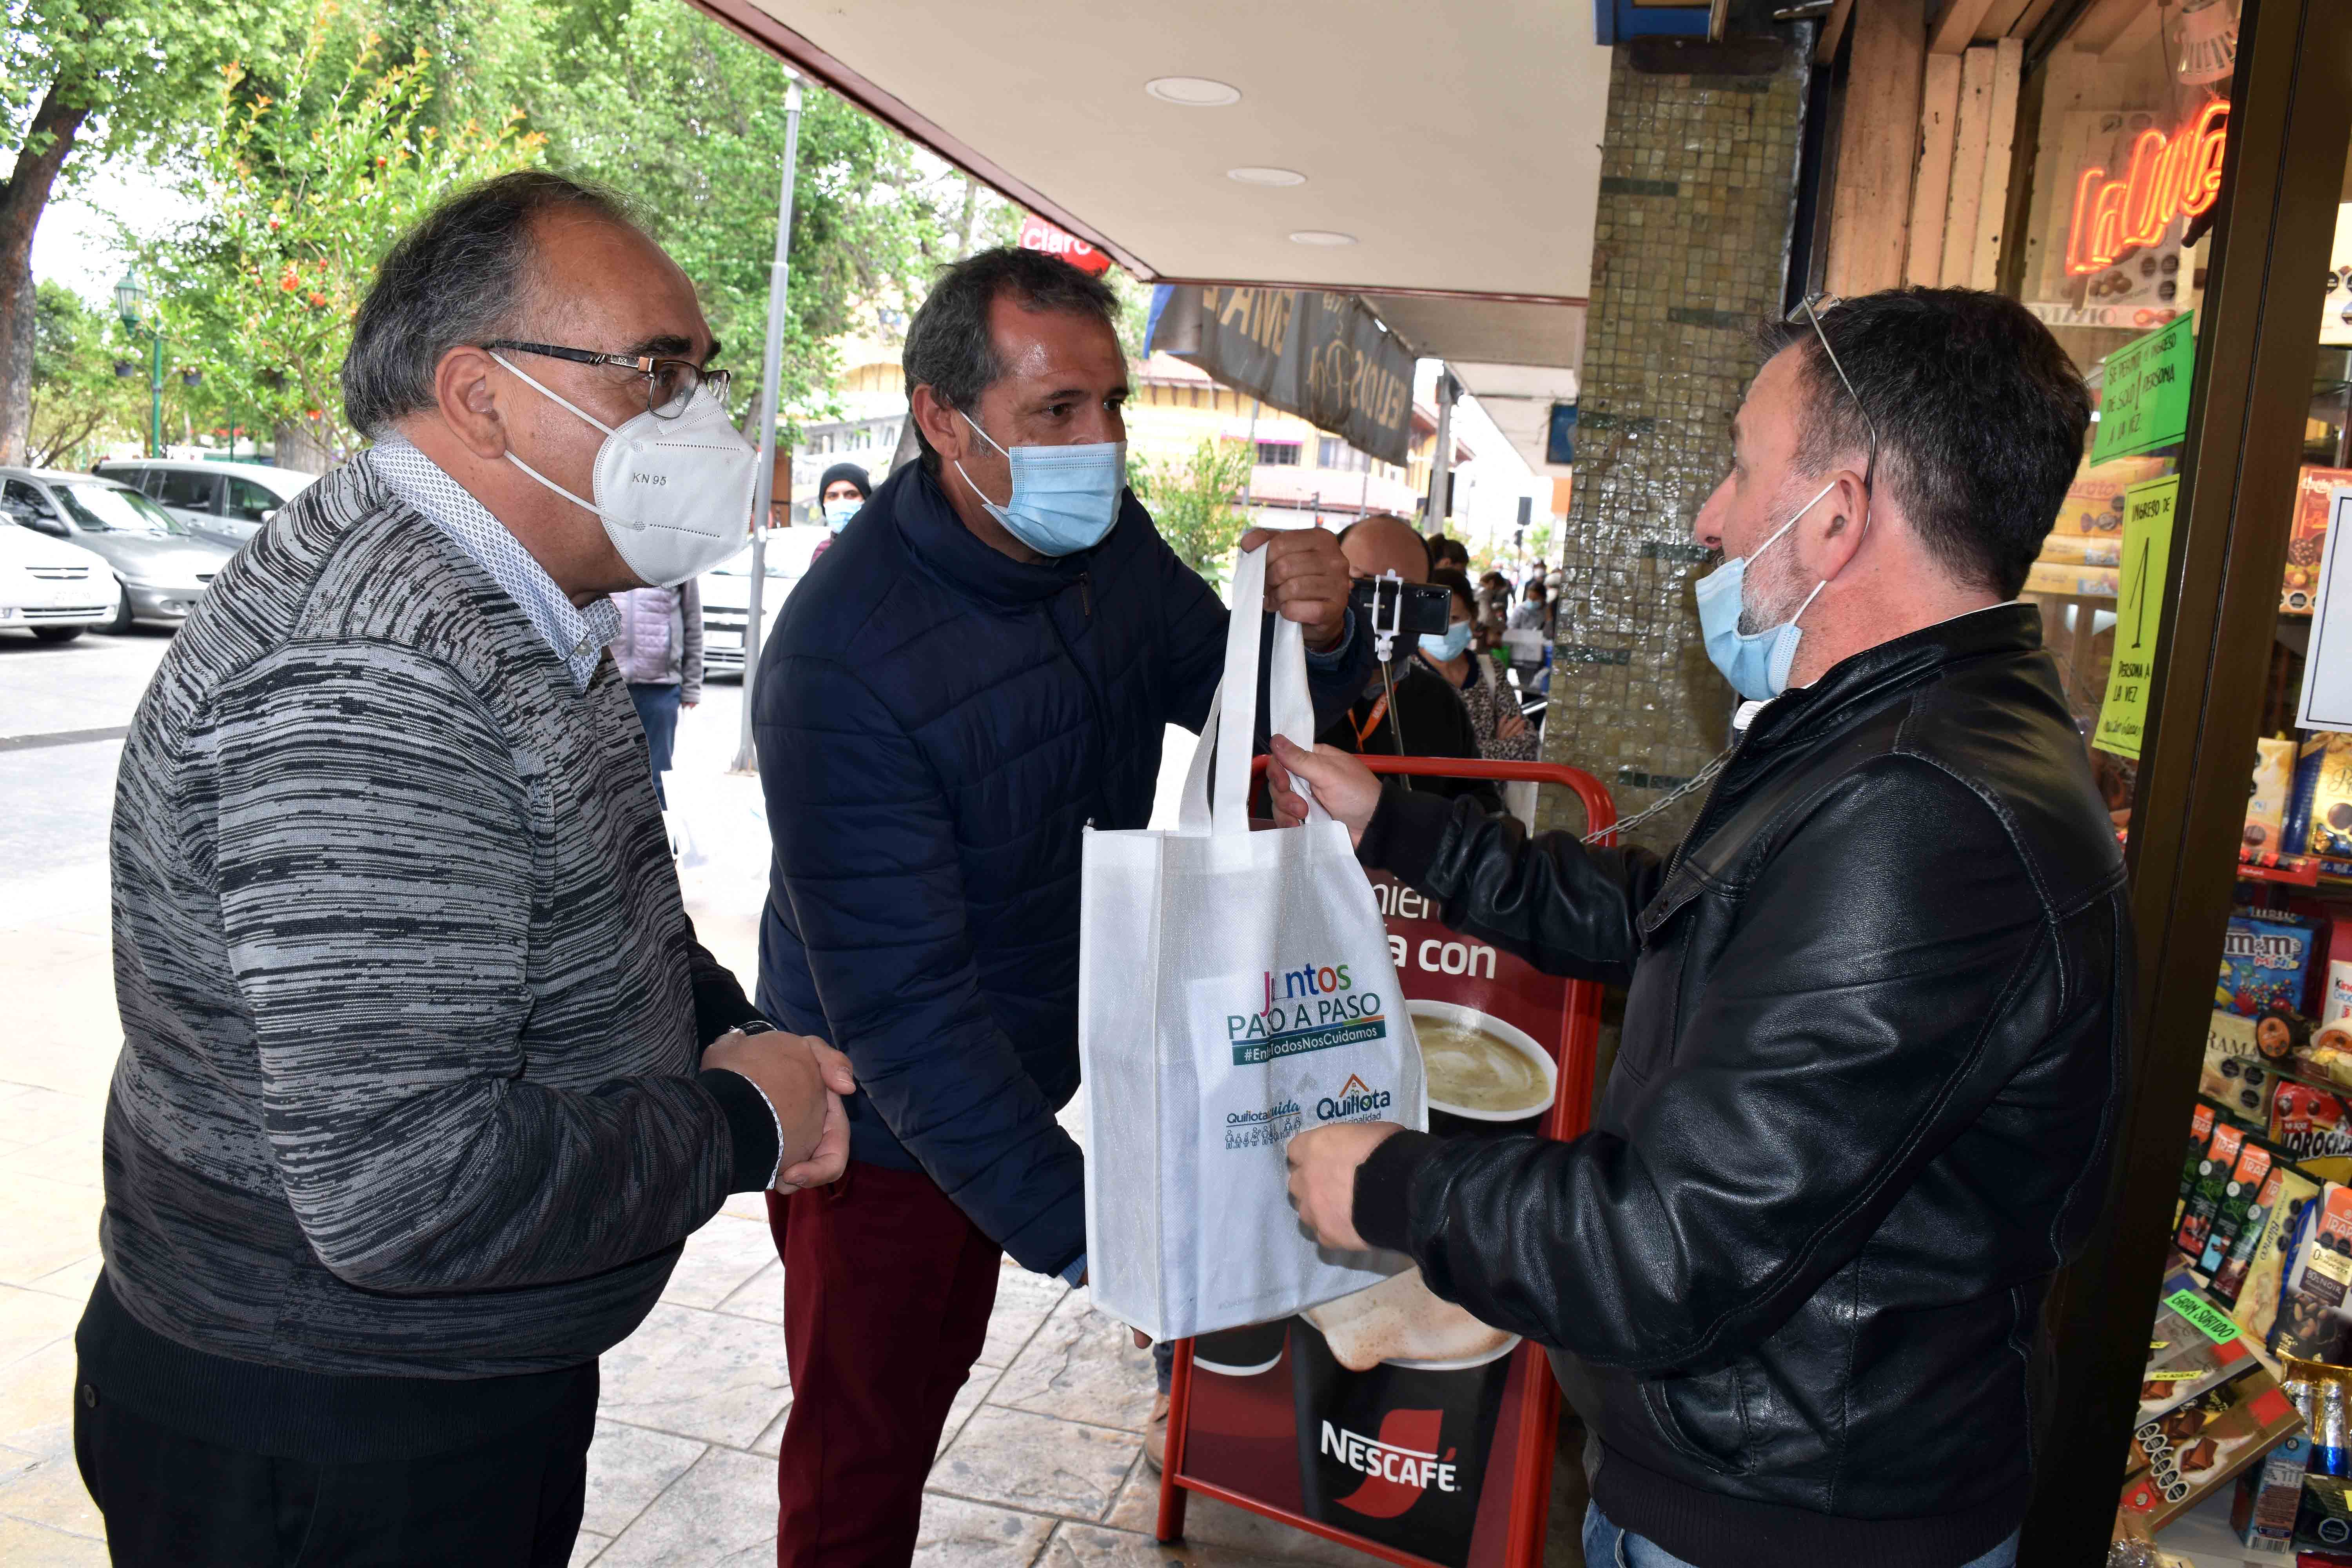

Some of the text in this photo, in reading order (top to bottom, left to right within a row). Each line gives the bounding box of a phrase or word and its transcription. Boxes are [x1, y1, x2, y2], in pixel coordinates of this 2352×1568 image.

[2142, 363, 2175, 394] PERSONA
[632, 473, 666, 486] KN 95
[2131, 496, 2171, 523] INGRESO DE
[2118, 661, 2150, 680] PERSONA A
[2112, 685, 2138, 703] LA VEZ
[1418, 939, 1497, 979] con
[1227, 992, 1381, 1040] PAO A PASO
[2193, 1309, 2235, 1338] SURTIDO
[1321, 1419, 1456, 1492] NESCAFÉ
